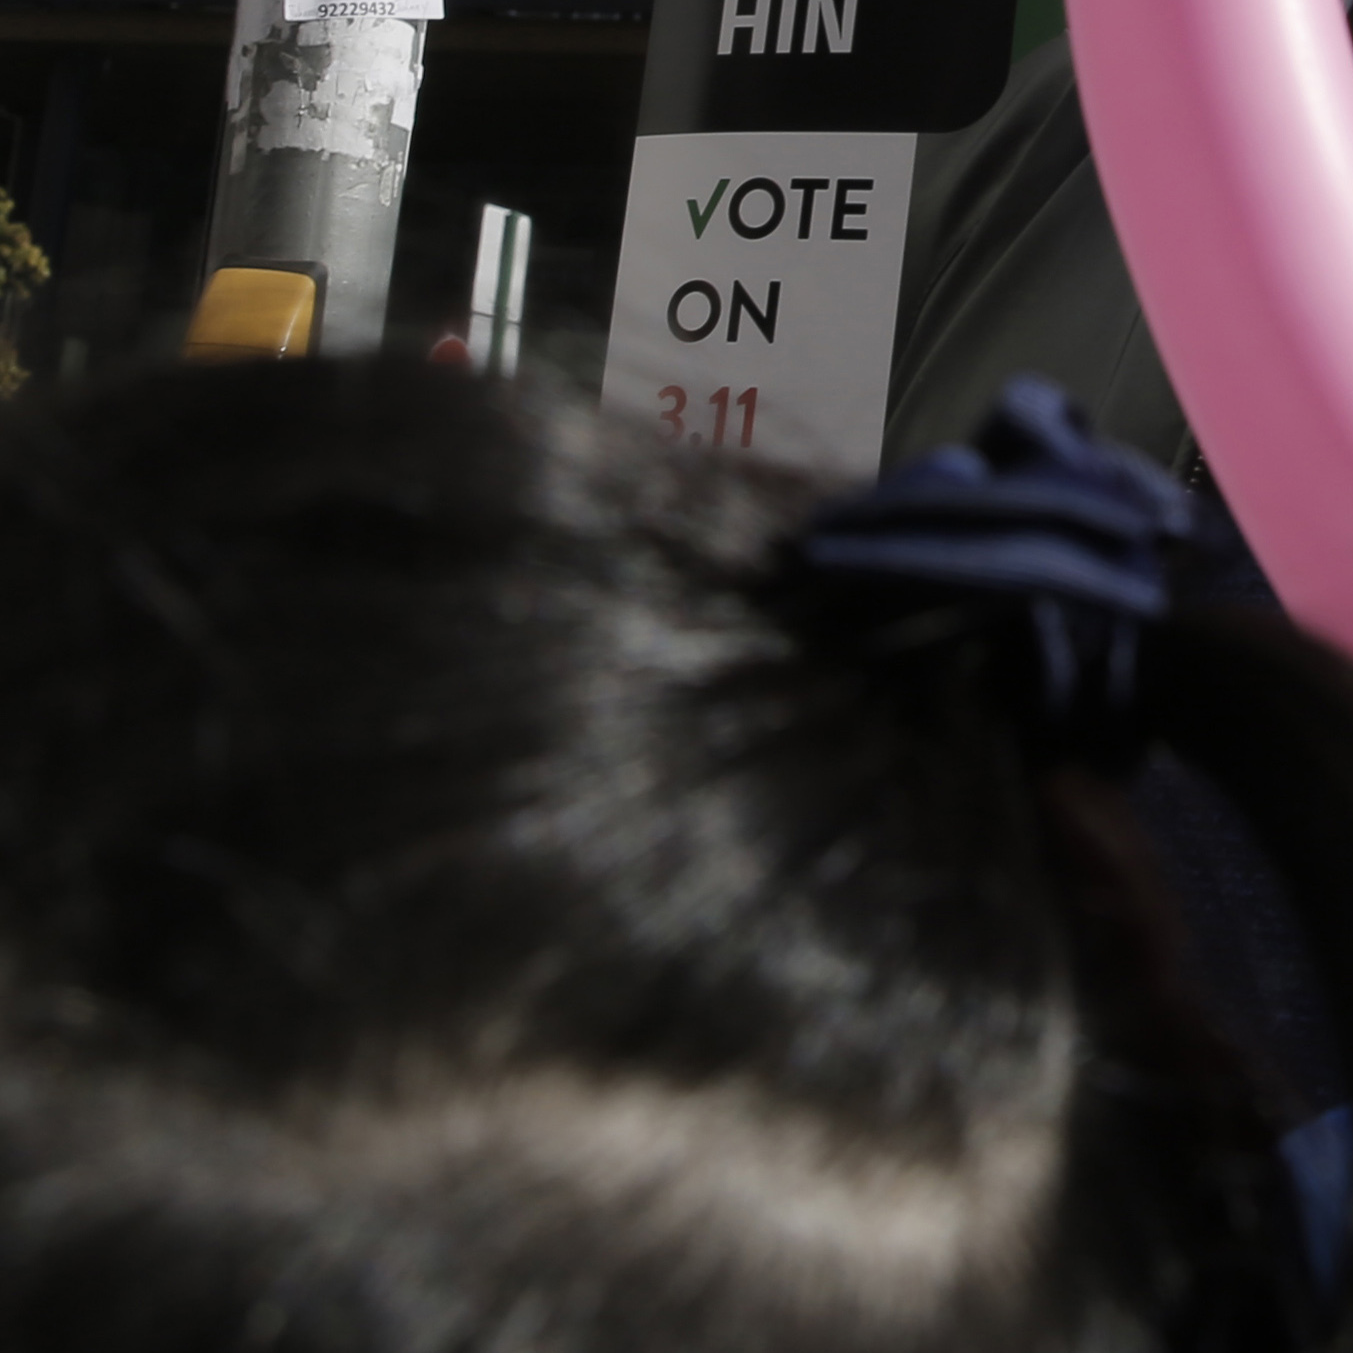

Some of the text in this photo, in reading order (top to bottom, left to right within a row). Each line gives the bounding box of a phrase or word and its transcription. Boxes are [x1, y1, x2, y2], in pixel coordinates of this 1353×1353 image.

[318, 2, 396, 18] 92229432
[686, 177, 874, 241] VOTE
[667, 279, 781, 344] ON
[655, 385, 758, 448] 3.11
